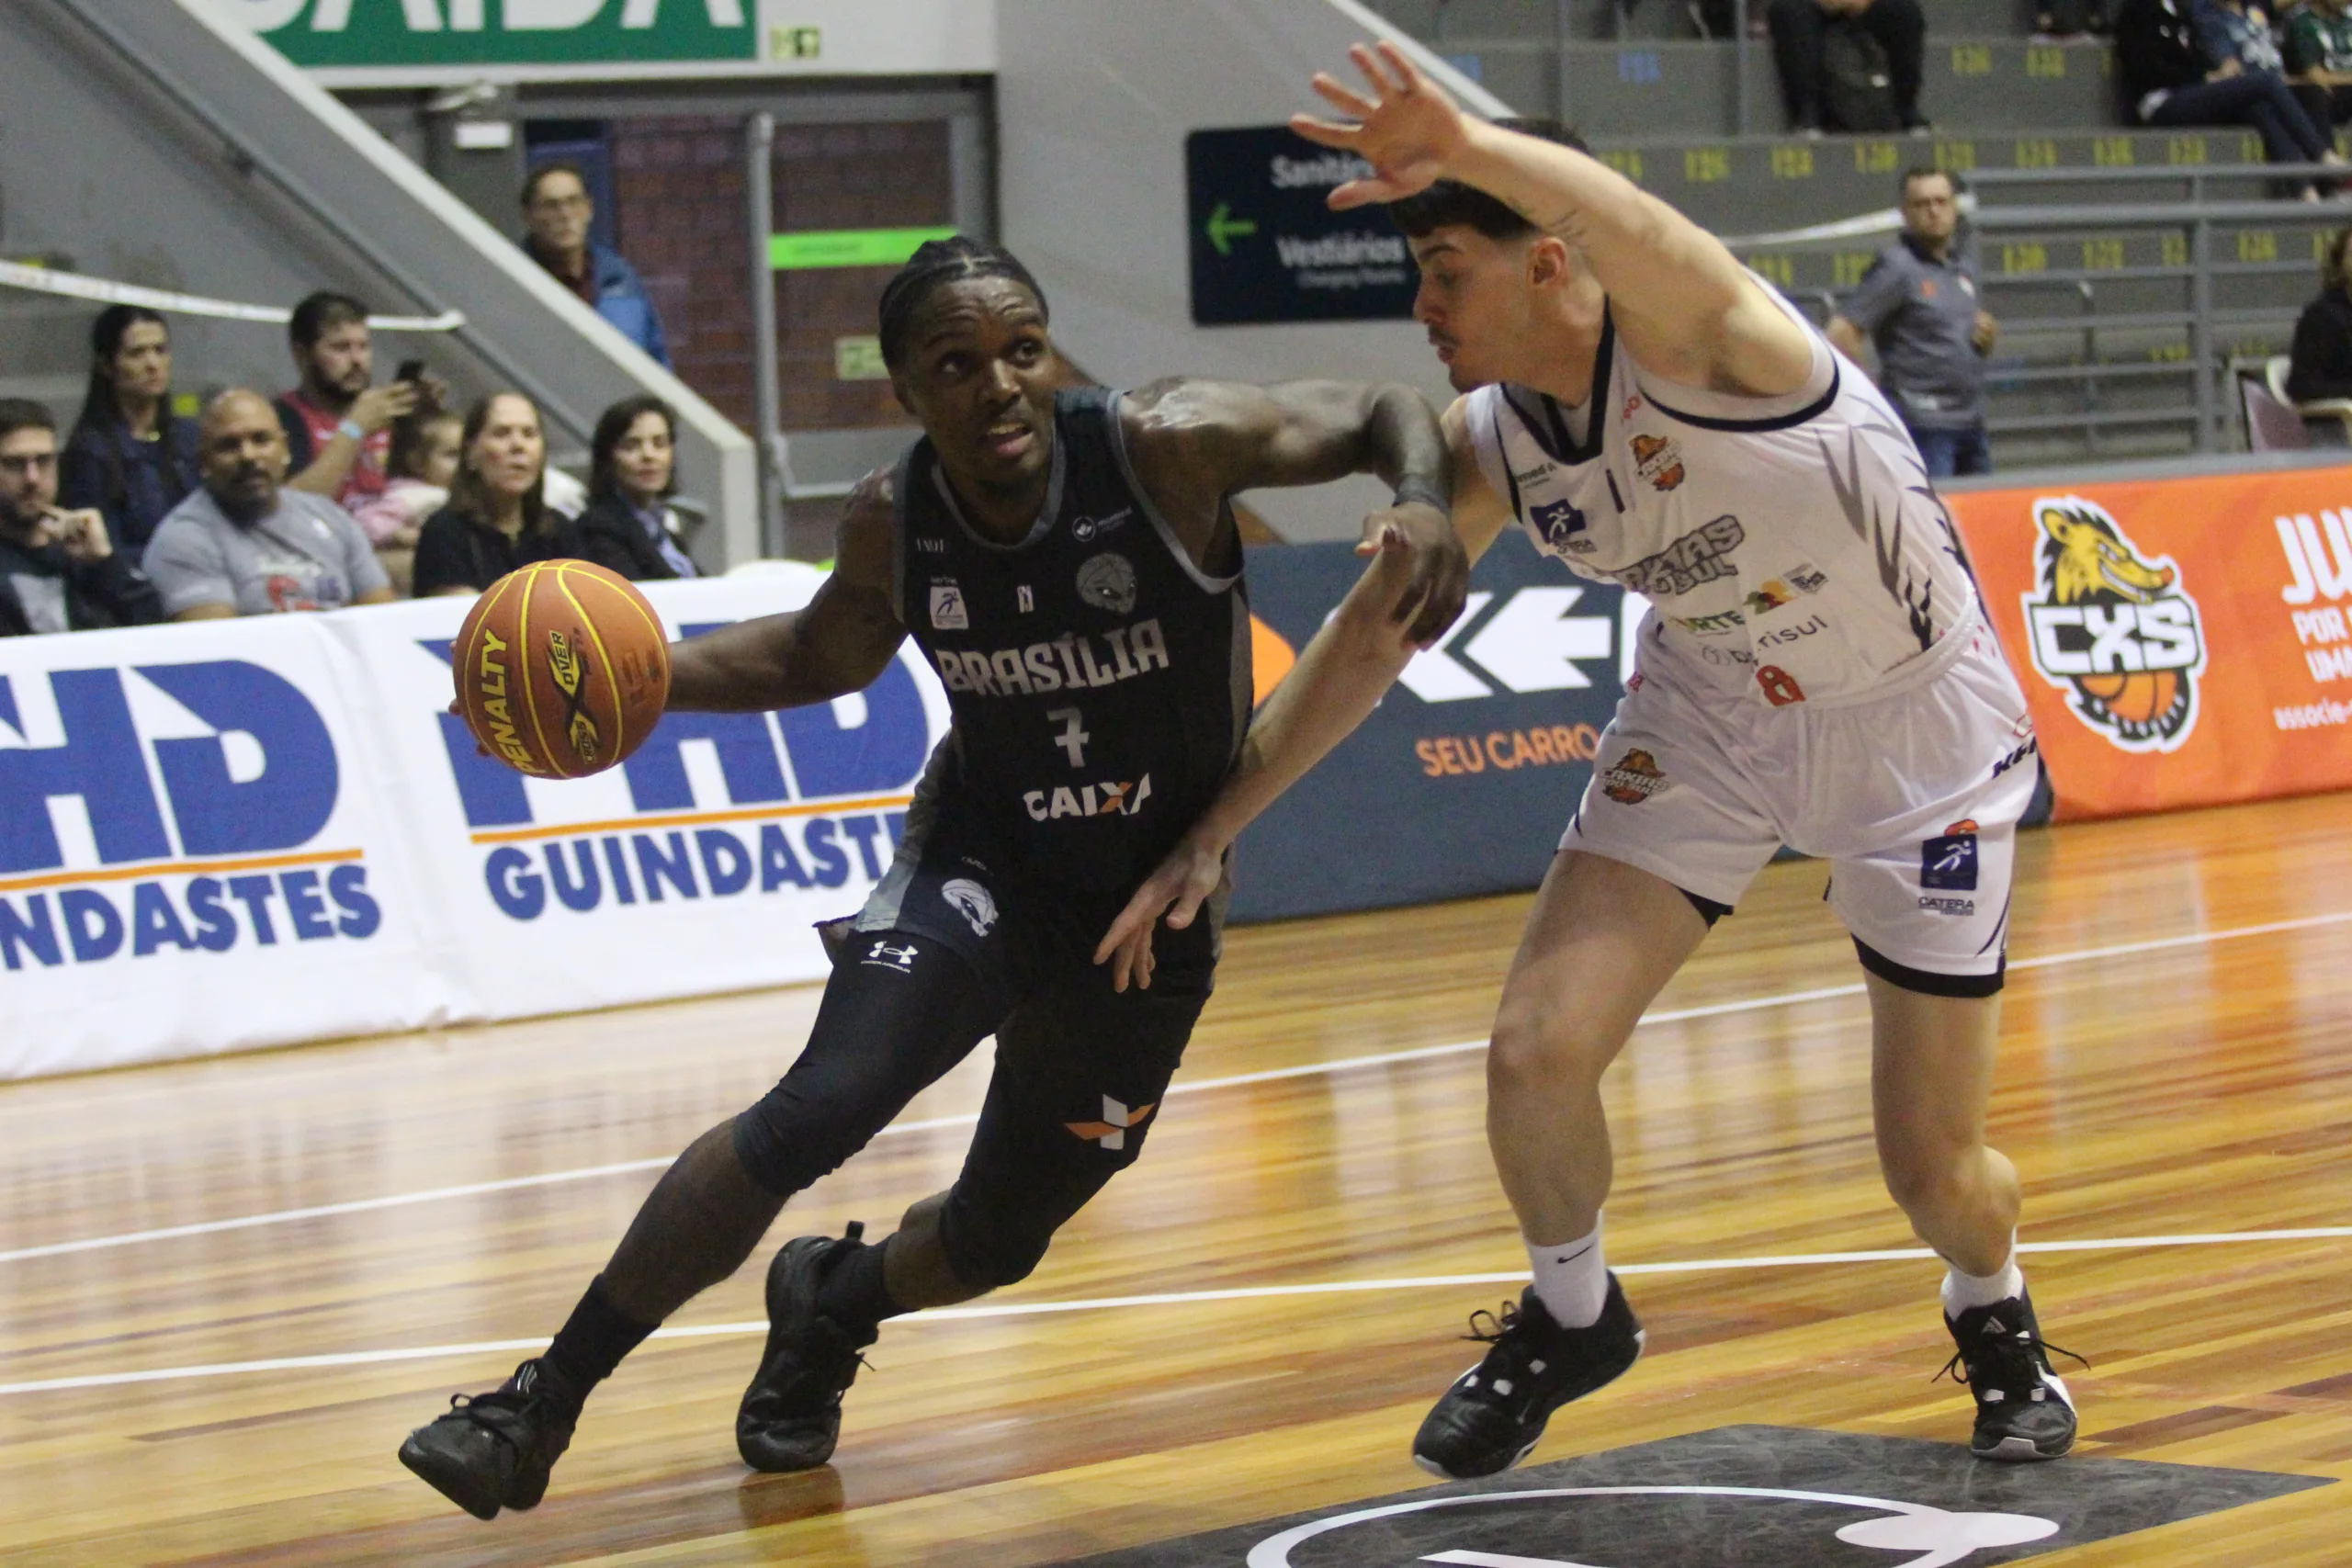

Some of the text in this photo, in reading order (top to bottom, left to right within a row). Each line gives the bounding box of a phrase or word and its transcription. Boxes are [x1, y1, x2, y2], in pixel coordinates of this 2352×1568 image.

[934, 617, 1170, 697] BRASÍLIA
[2029, 597, 2200, 675] CXS
[481, 628, 548, 775] PENALTY
[1046, 707, 1091, 768] 7
[0, 659, 340, 874] HD
[1415, 723, 1600, 777] SEU CARRO
[1023, 772, 1151, 822] CAIXA
[0, 863, 381, 970] NDASTES
